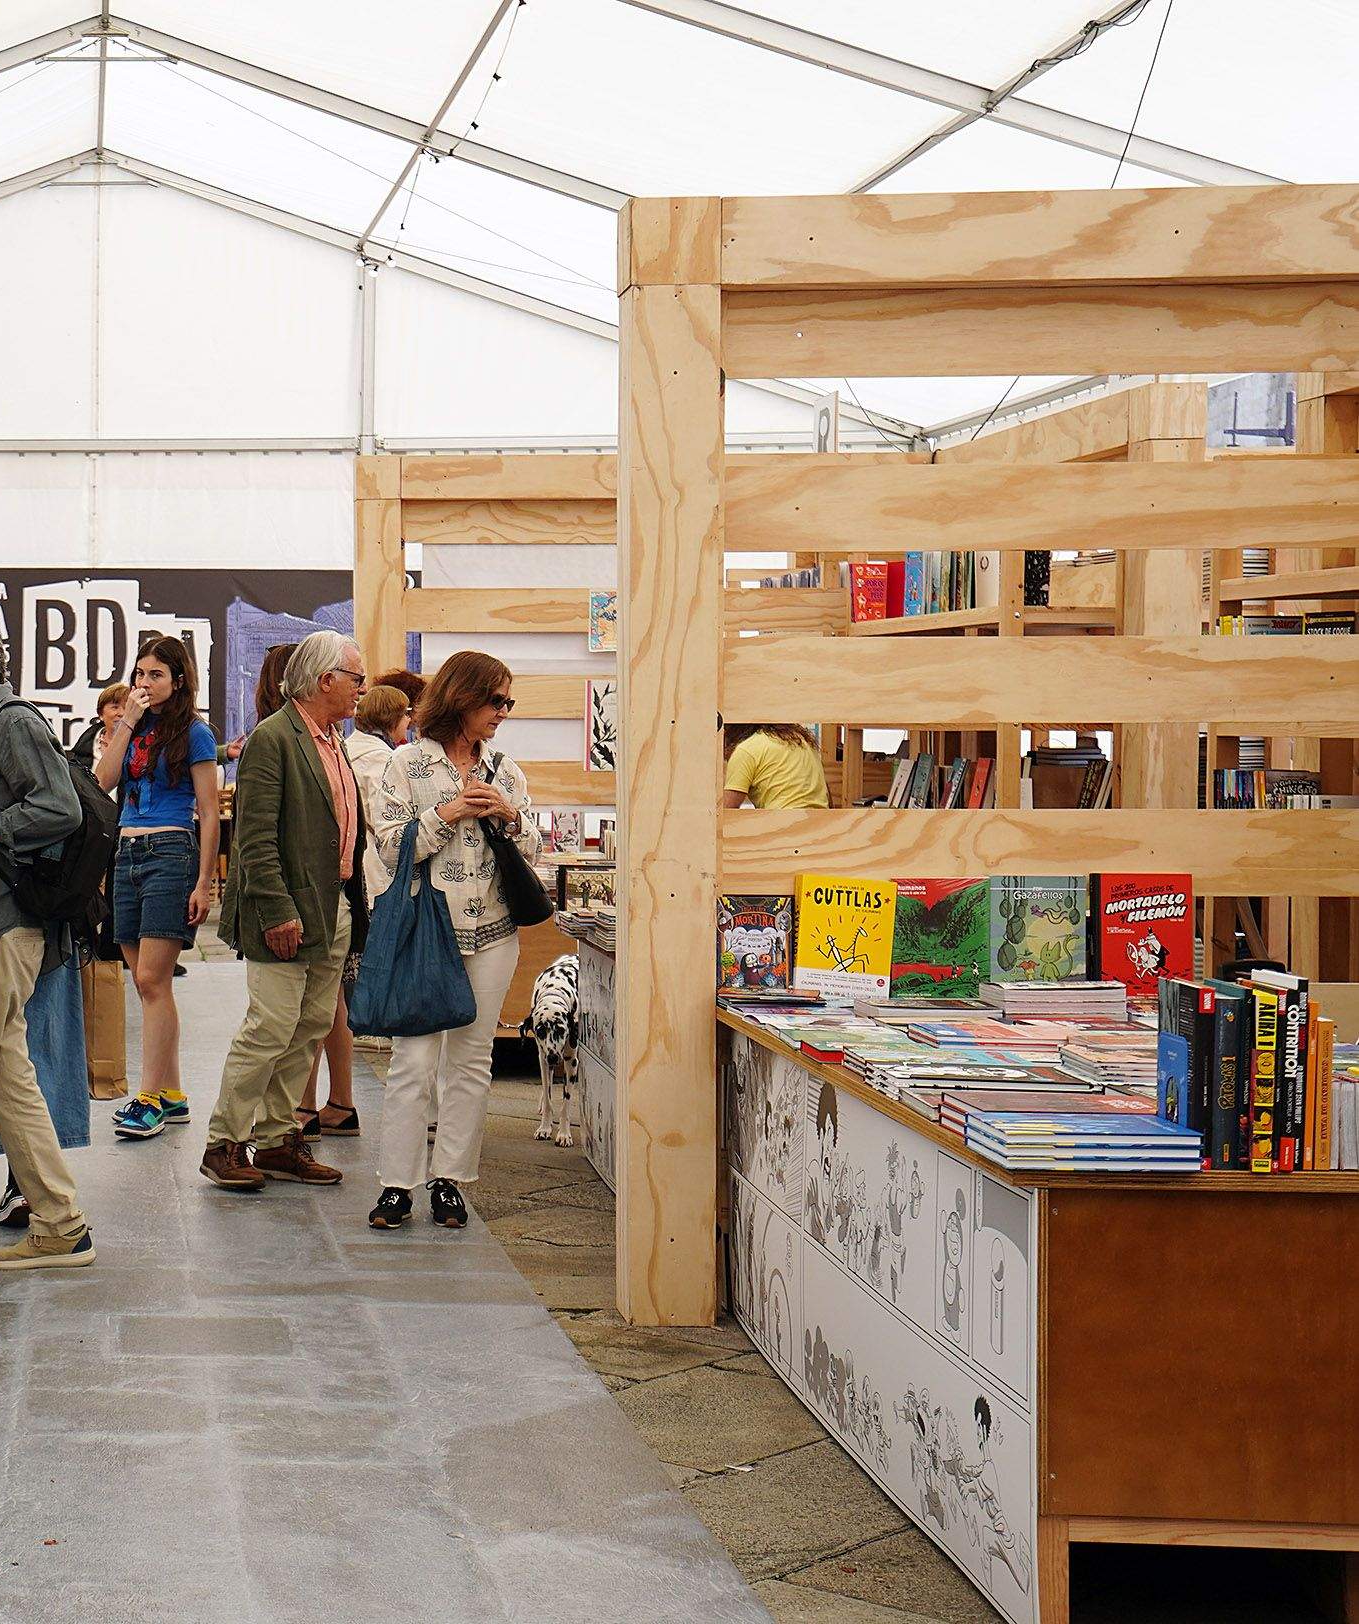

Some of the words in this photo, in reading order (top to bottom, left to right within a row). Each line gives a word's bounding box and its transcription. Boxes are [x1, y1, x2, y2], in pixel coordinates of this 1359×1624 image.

[814, 887, 882, 909] CUTTLAS
[1105, 893, 1186, 915] MORTADELO
[735, 913, 776, 927] MORTINA
[1127, 904, 1187, 923] FILEMÓN
[1258, 1002, 1277, 1037] AKIRA
[1284, 1004, 1300, 1079] CONTRITION
